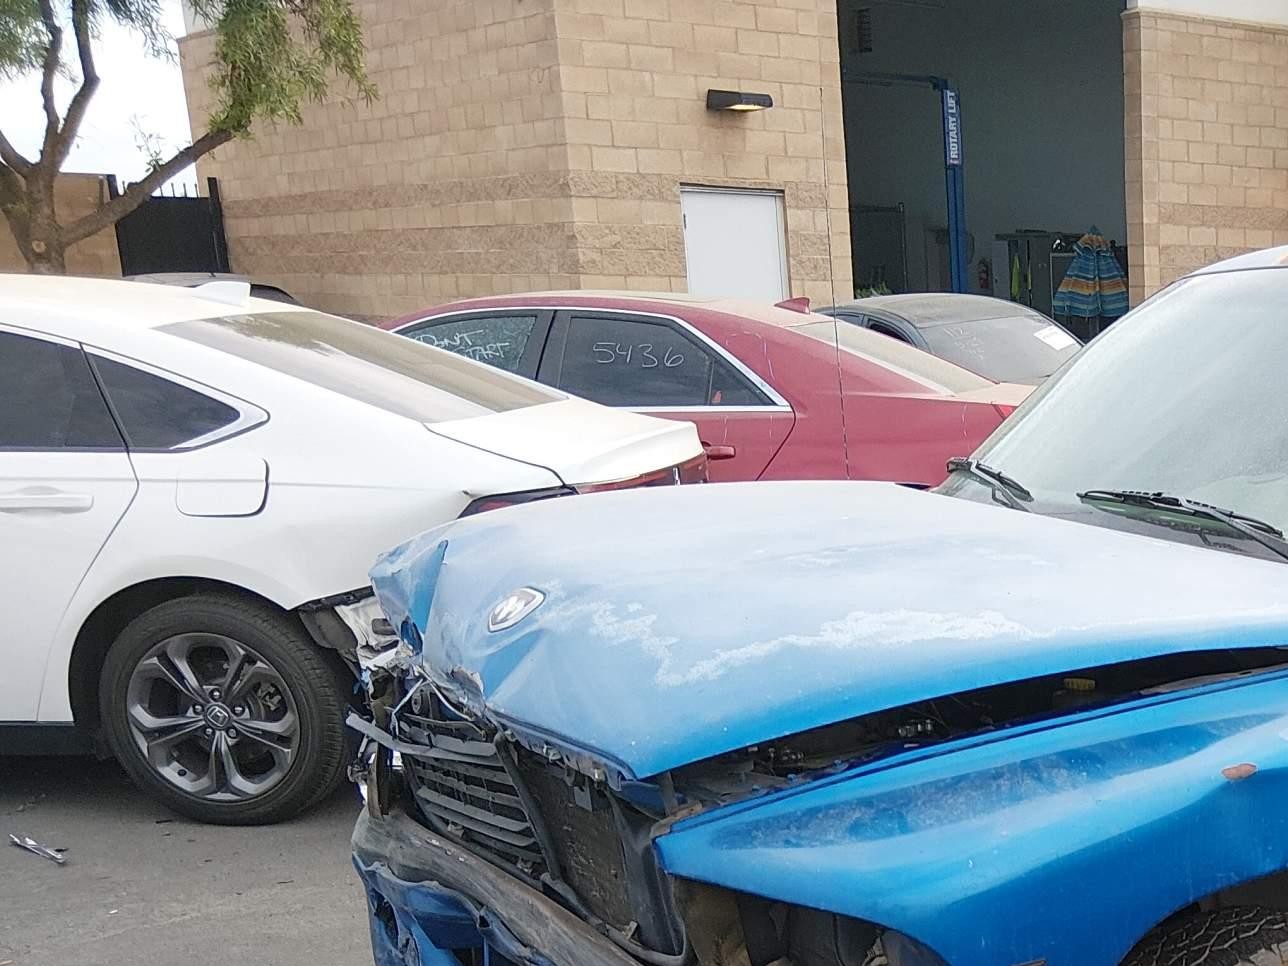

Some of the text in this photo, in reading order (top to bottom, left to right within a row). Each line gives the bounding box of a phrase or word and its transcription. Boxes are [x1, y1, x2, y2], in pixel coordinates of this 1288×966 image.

[947, 90, 959, 159] ROTARY LIFT
[592, 342, 685, 368] 5436
